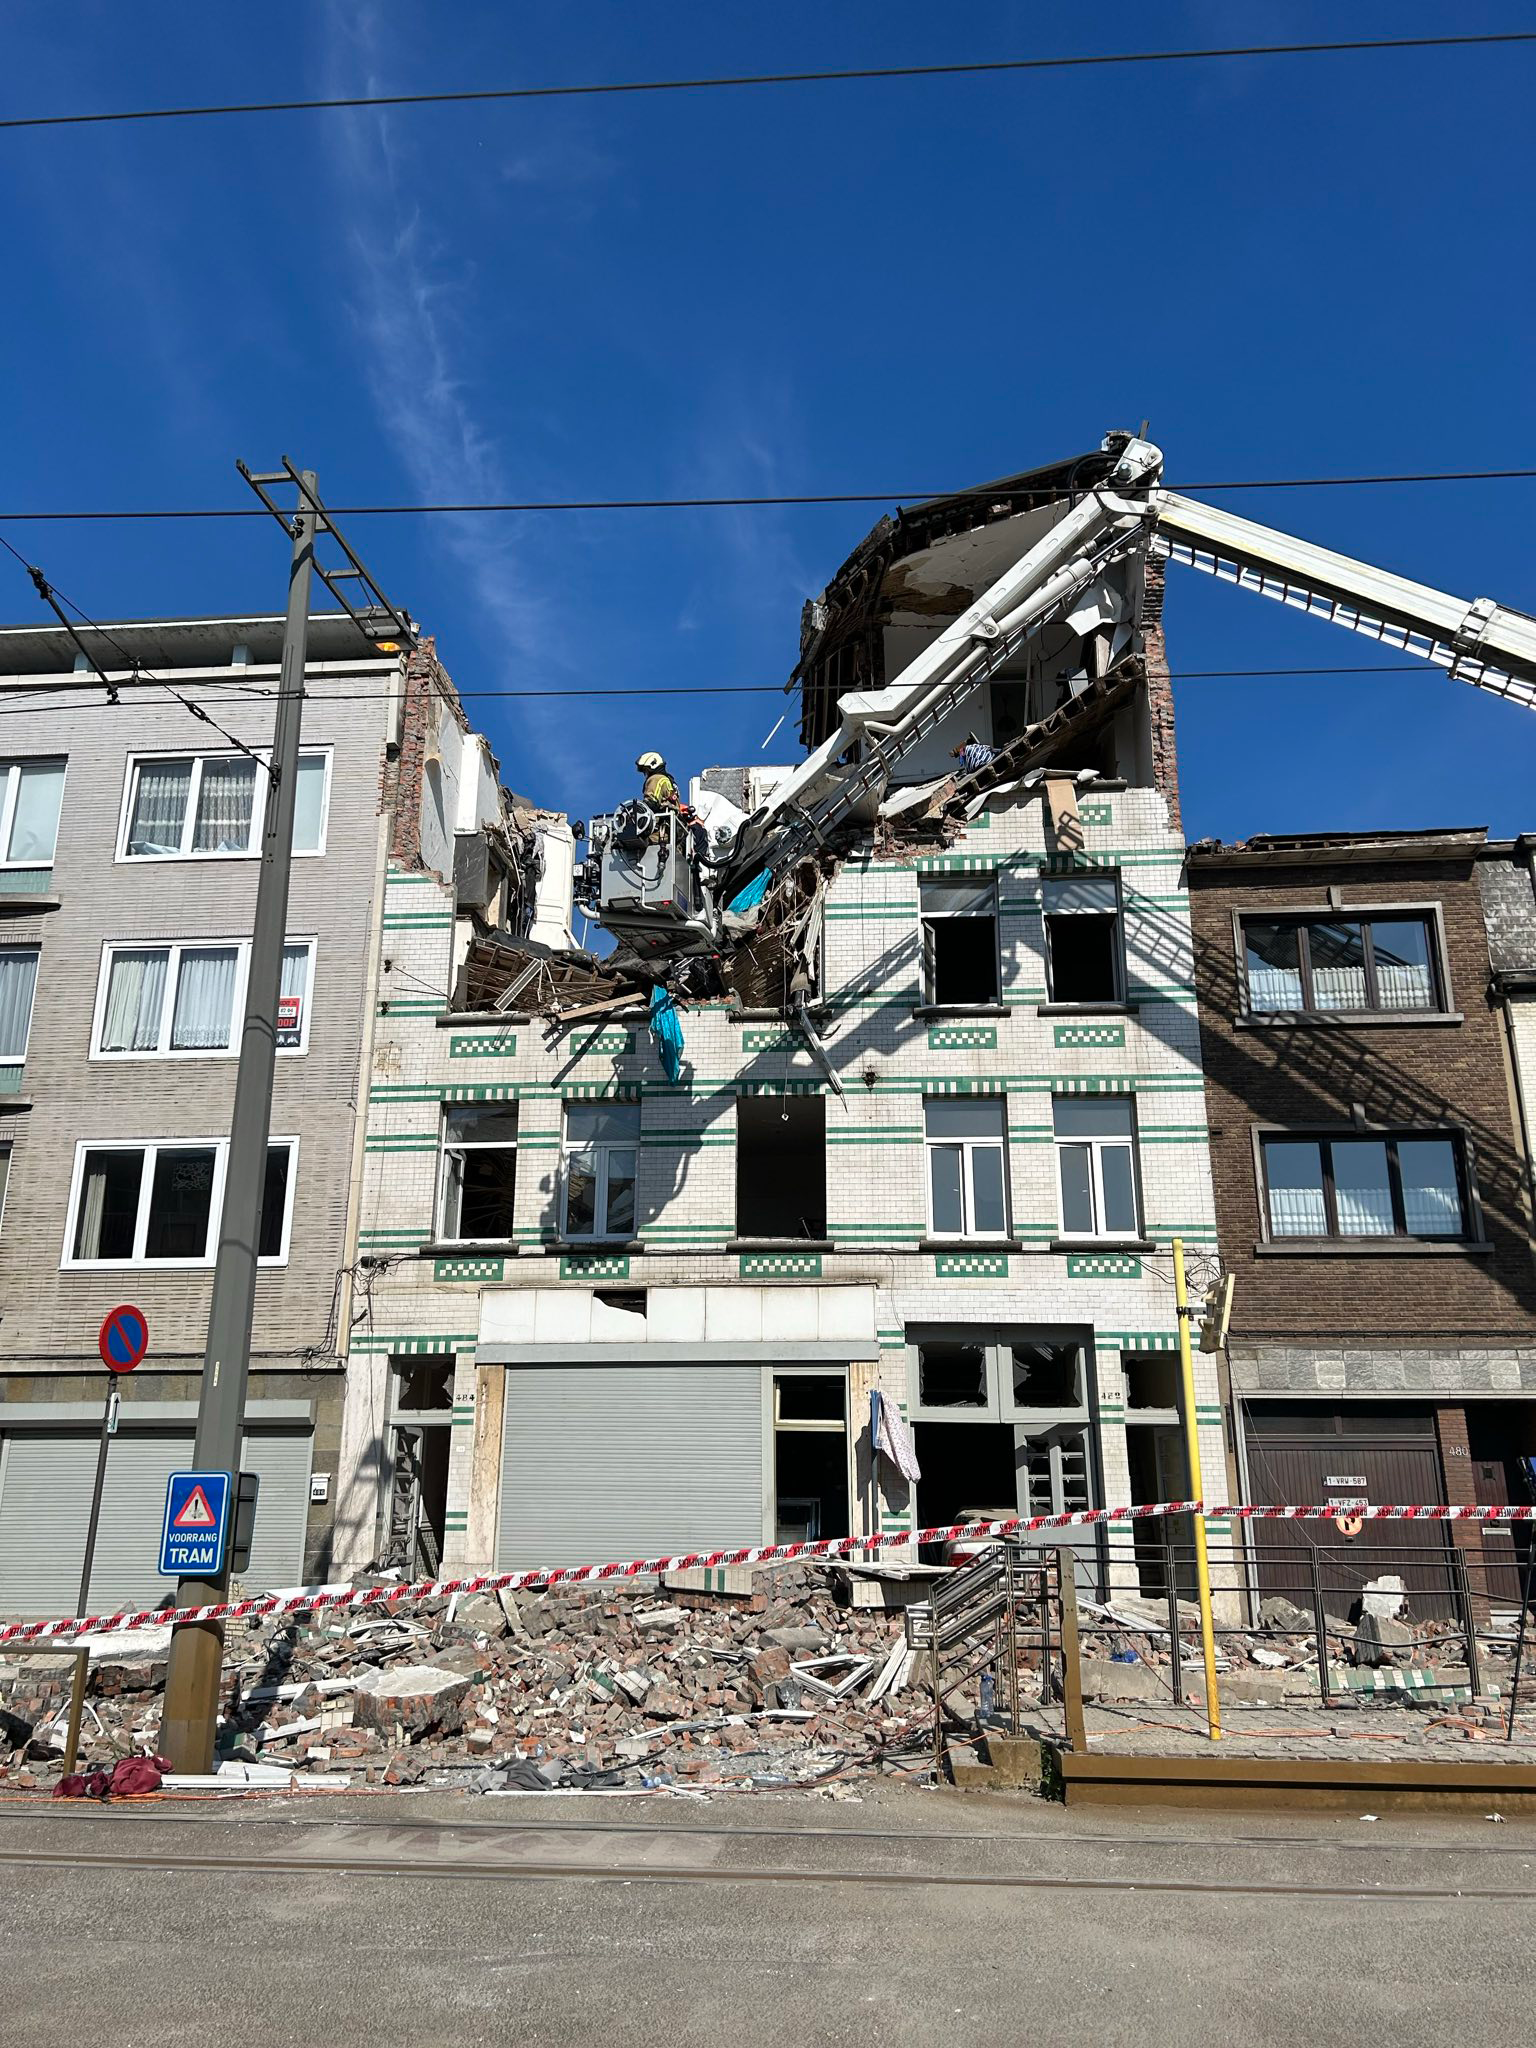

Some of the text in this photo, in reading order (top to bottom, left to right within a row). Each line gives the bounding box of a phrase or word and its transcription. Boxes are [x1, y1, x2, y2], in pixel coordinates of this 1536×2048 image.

[277, 1018, 295, 1027] OOP
[1449, 1446, 1469, 1456] 480
[1081, 1511, 1110, 1523] POMPIERS
[1295, 1507, 1367, 1516] BRANDWEER POMPIERS
[1377, 1507, 1449, 1516] BRANDWEER POMPIERS
[1459, 1508, 1532, 1517] BRANDWEER POMPIERS
[1000, 1516, 1071, 1533] BRANDWEER POMPIERS
[168, 1533, 217, 1543] VOORRANG
[918, 1525, 990, 1541] BRANDWEER POMPIERS
[838, 1533, 909, 1550] BRANDWEER POMPIERS
[169, 1548, 214, 1564] TRAM
[758, 1542, 828, 1559] BRANDWEER POMPIERS
[678, 1551, 748, 1569] BRANDWEER POMPIERS
[519, 1569, 589, 1585] BRANDWEER POMPIERS
[598, 1561, 668, 1577] BRANDWEER POMPIERS
[440, 1577, 510, 1594] BRANDWEER POMPIERS
[284, 1593, 353, 1609] BRANDWEER POMPIERS
[362, 1586, 431, 1602] BRANDWEER POMPIERS
[129, 1608, 198, 1625] BRANDWEER POMPIERS
[207, 1601, 275, 1616] BRANDWEER POMPIERS
[10, 1625, 43, 1638] BRANDWEER
[52, 1617, 120, 1634] BRANDWEER POMPIERS
